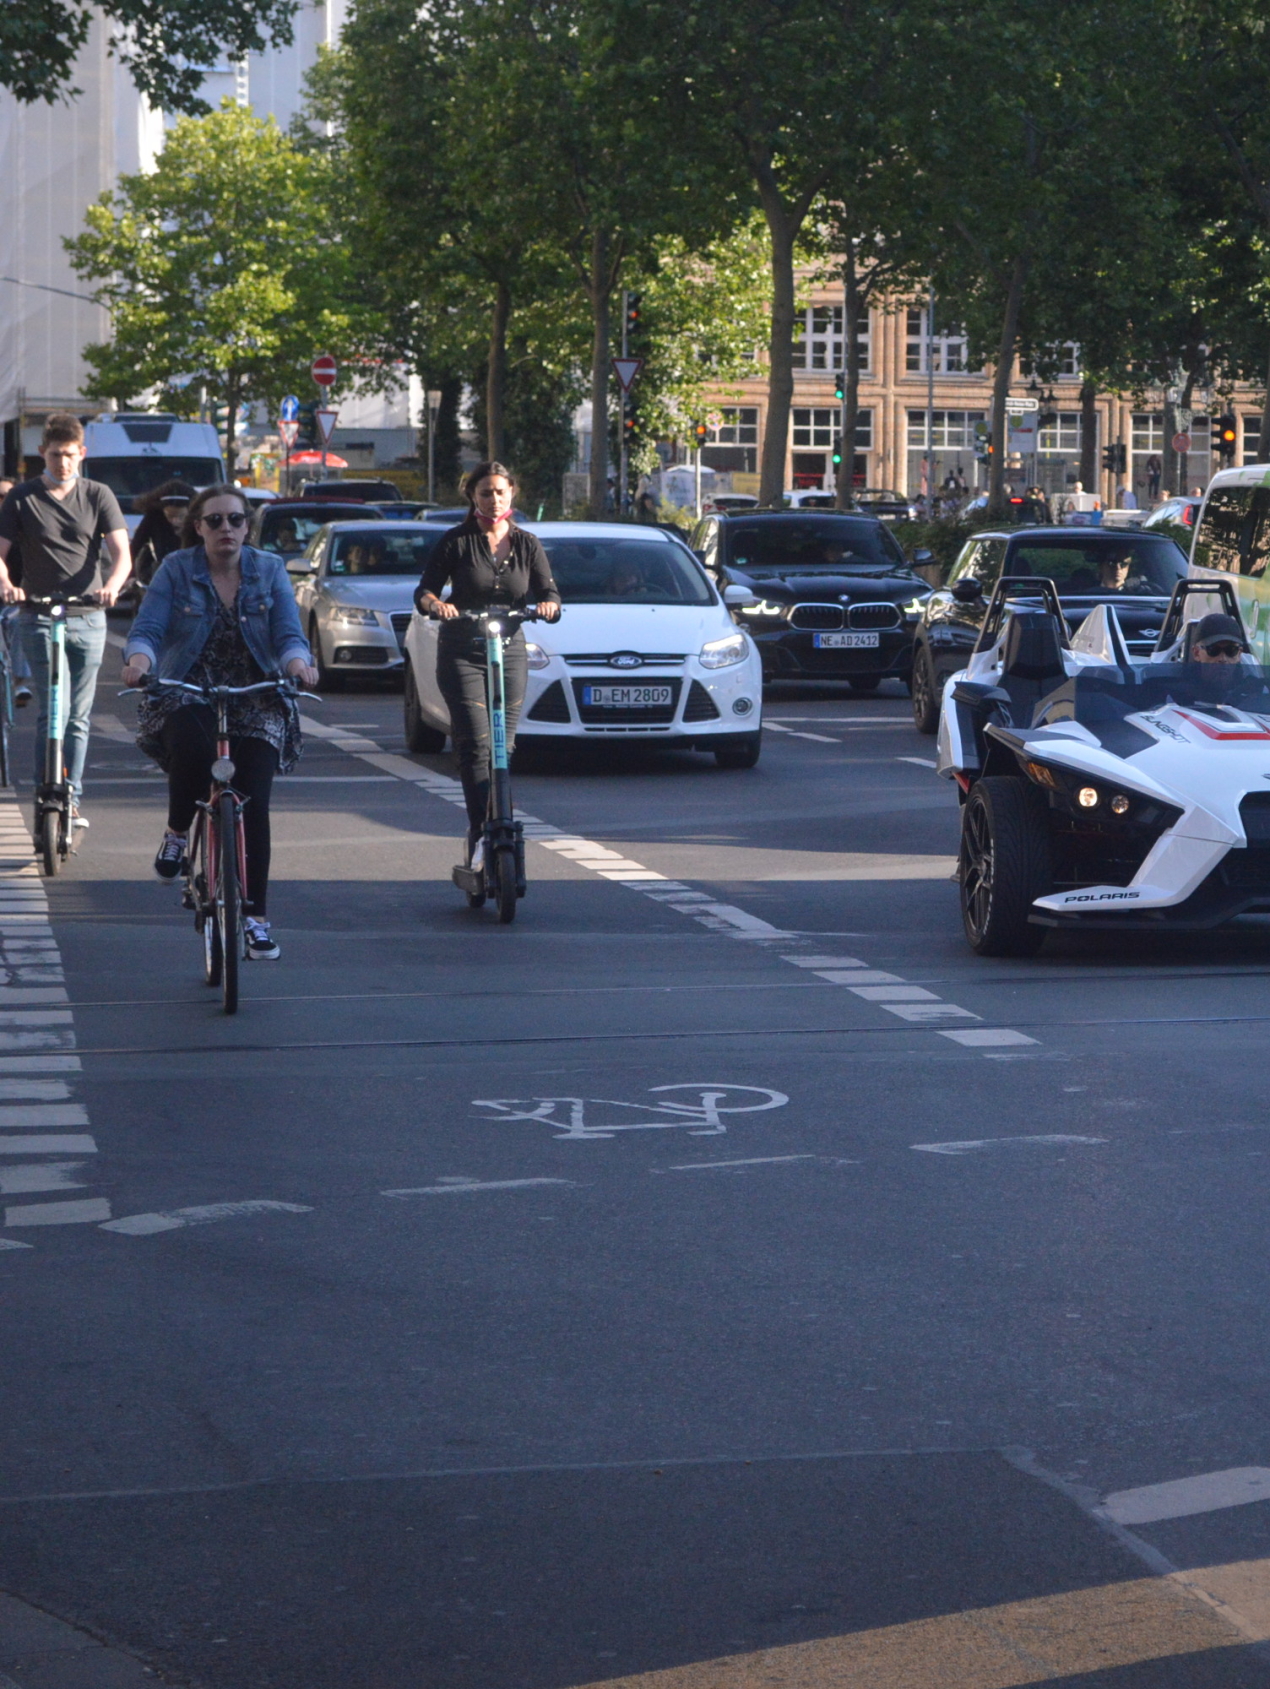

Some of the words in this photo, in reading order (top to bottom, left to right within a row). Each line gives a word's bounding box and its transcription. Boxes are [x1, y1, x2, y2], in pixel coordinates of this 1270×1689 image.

[821, 635, 833, 646] NE
[840, 635, 853, 646] AD
[854, 635, 878, 646] 2412
[593, 688, 602, 702] D
[611, 688, 630, 702] EM
[634, 688, 669, 703] 2809
[494, 712, 504, 765] TIER
[1064, 891, 1141, 904] POLARIS
